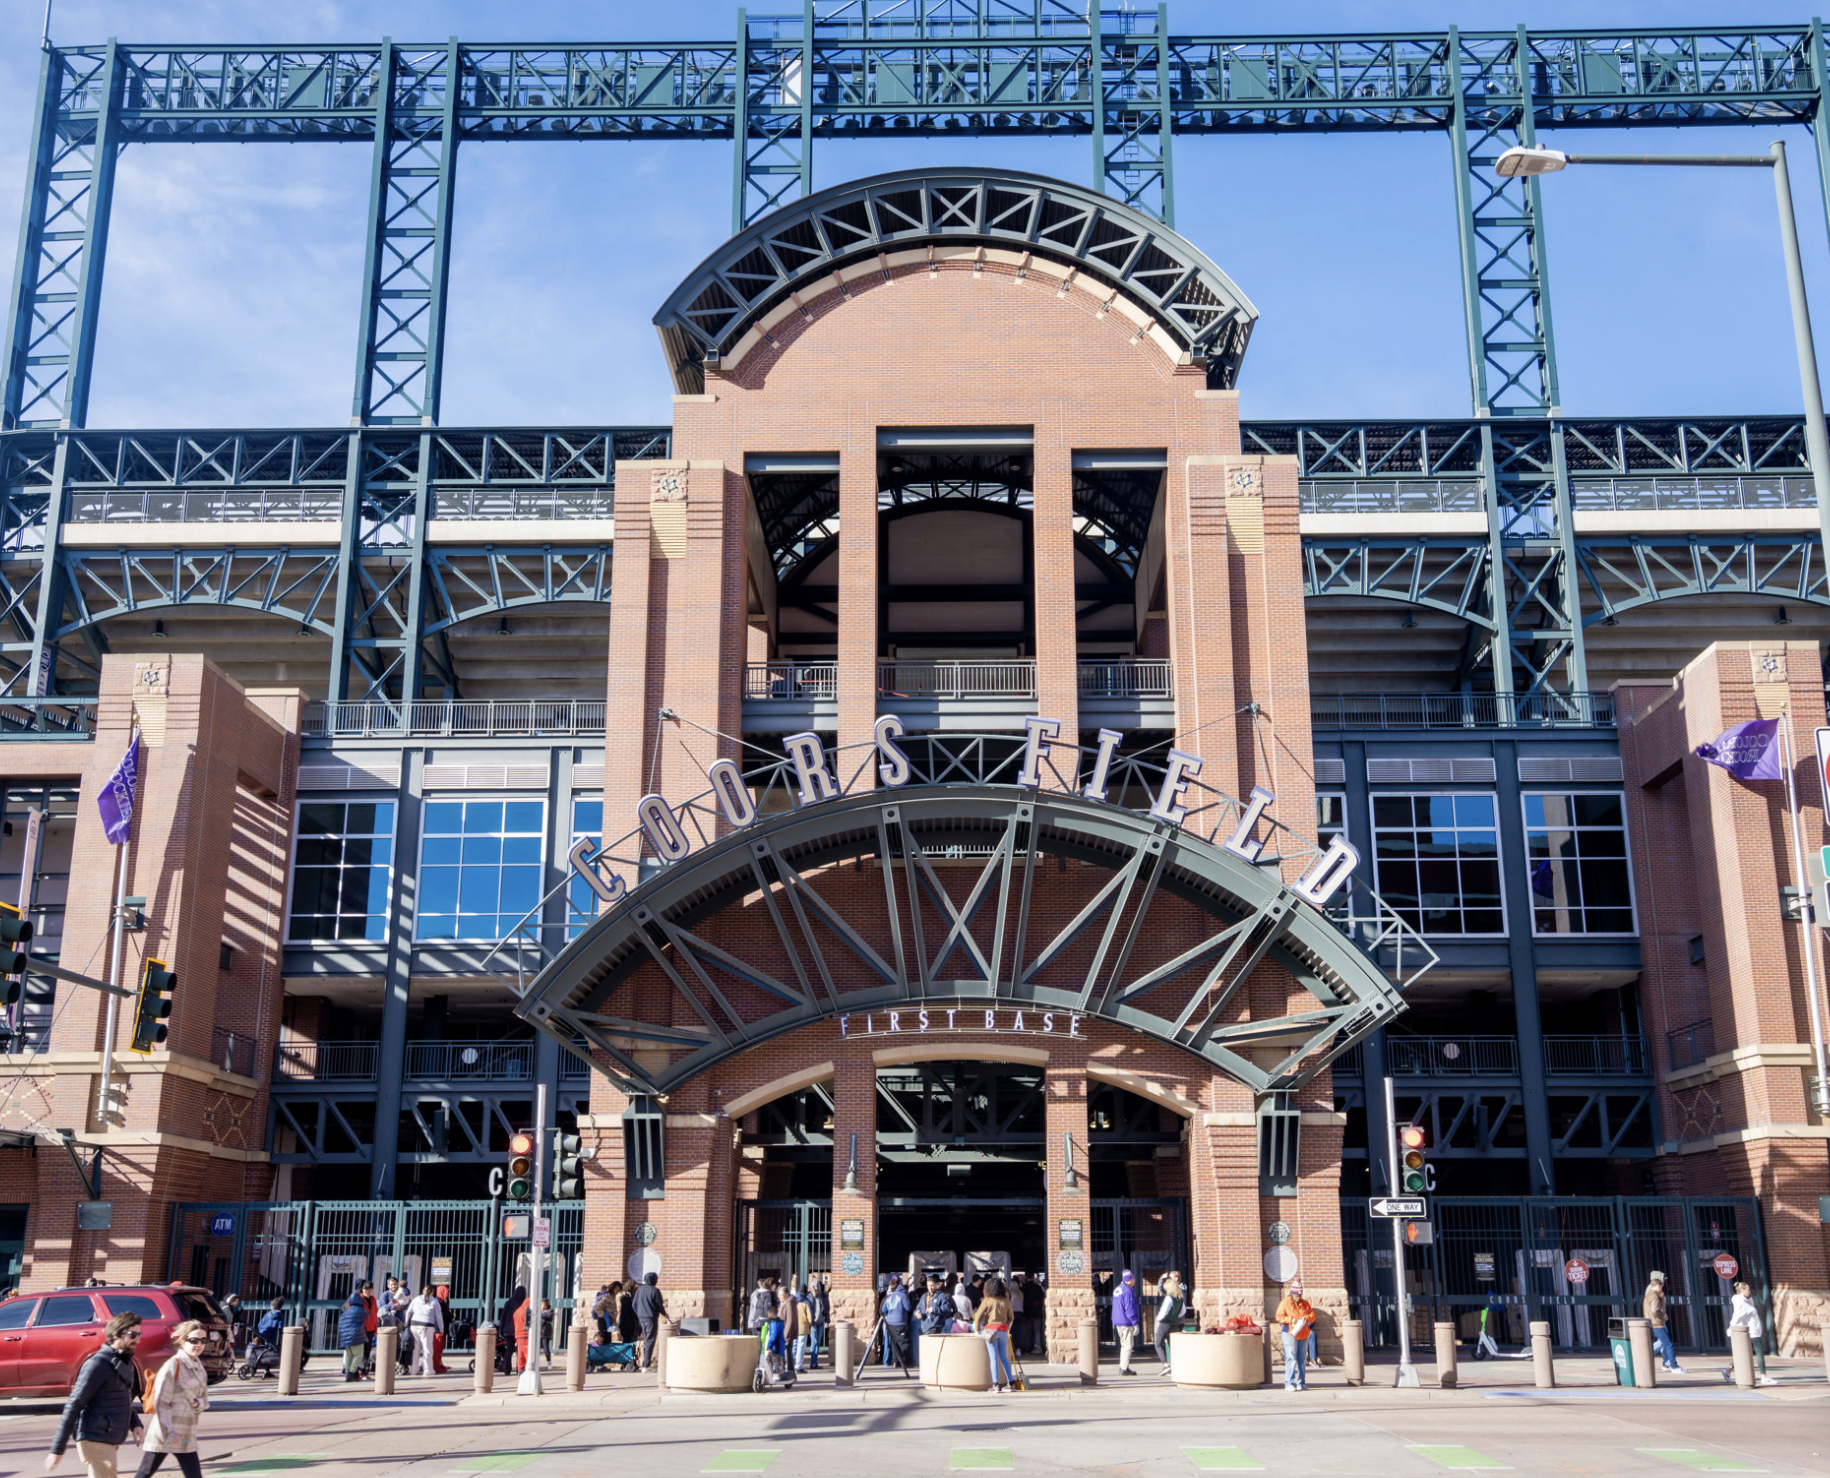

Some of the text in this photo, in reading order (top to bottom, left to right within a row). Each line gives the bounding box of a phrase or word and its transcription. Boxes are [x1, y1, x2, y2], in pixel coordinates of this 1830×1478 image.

[568, 714, 1361, 905] COORS FIELD
[840, 1009, 1081, 1037] FIRST BASE
[488, 1167, 504, 1196] C
[1425, 1163, 1437, 1191] C
[1386, 1203, 1419, 1211] ONE WAY
[214, 1218, 232, 1231] ATM
[1715, 1260, 1737, 1268] EXPRESS
[1567, 1271, 1587, 1280] TICKET
[1489, 1296, 1526, 1304] COORS
